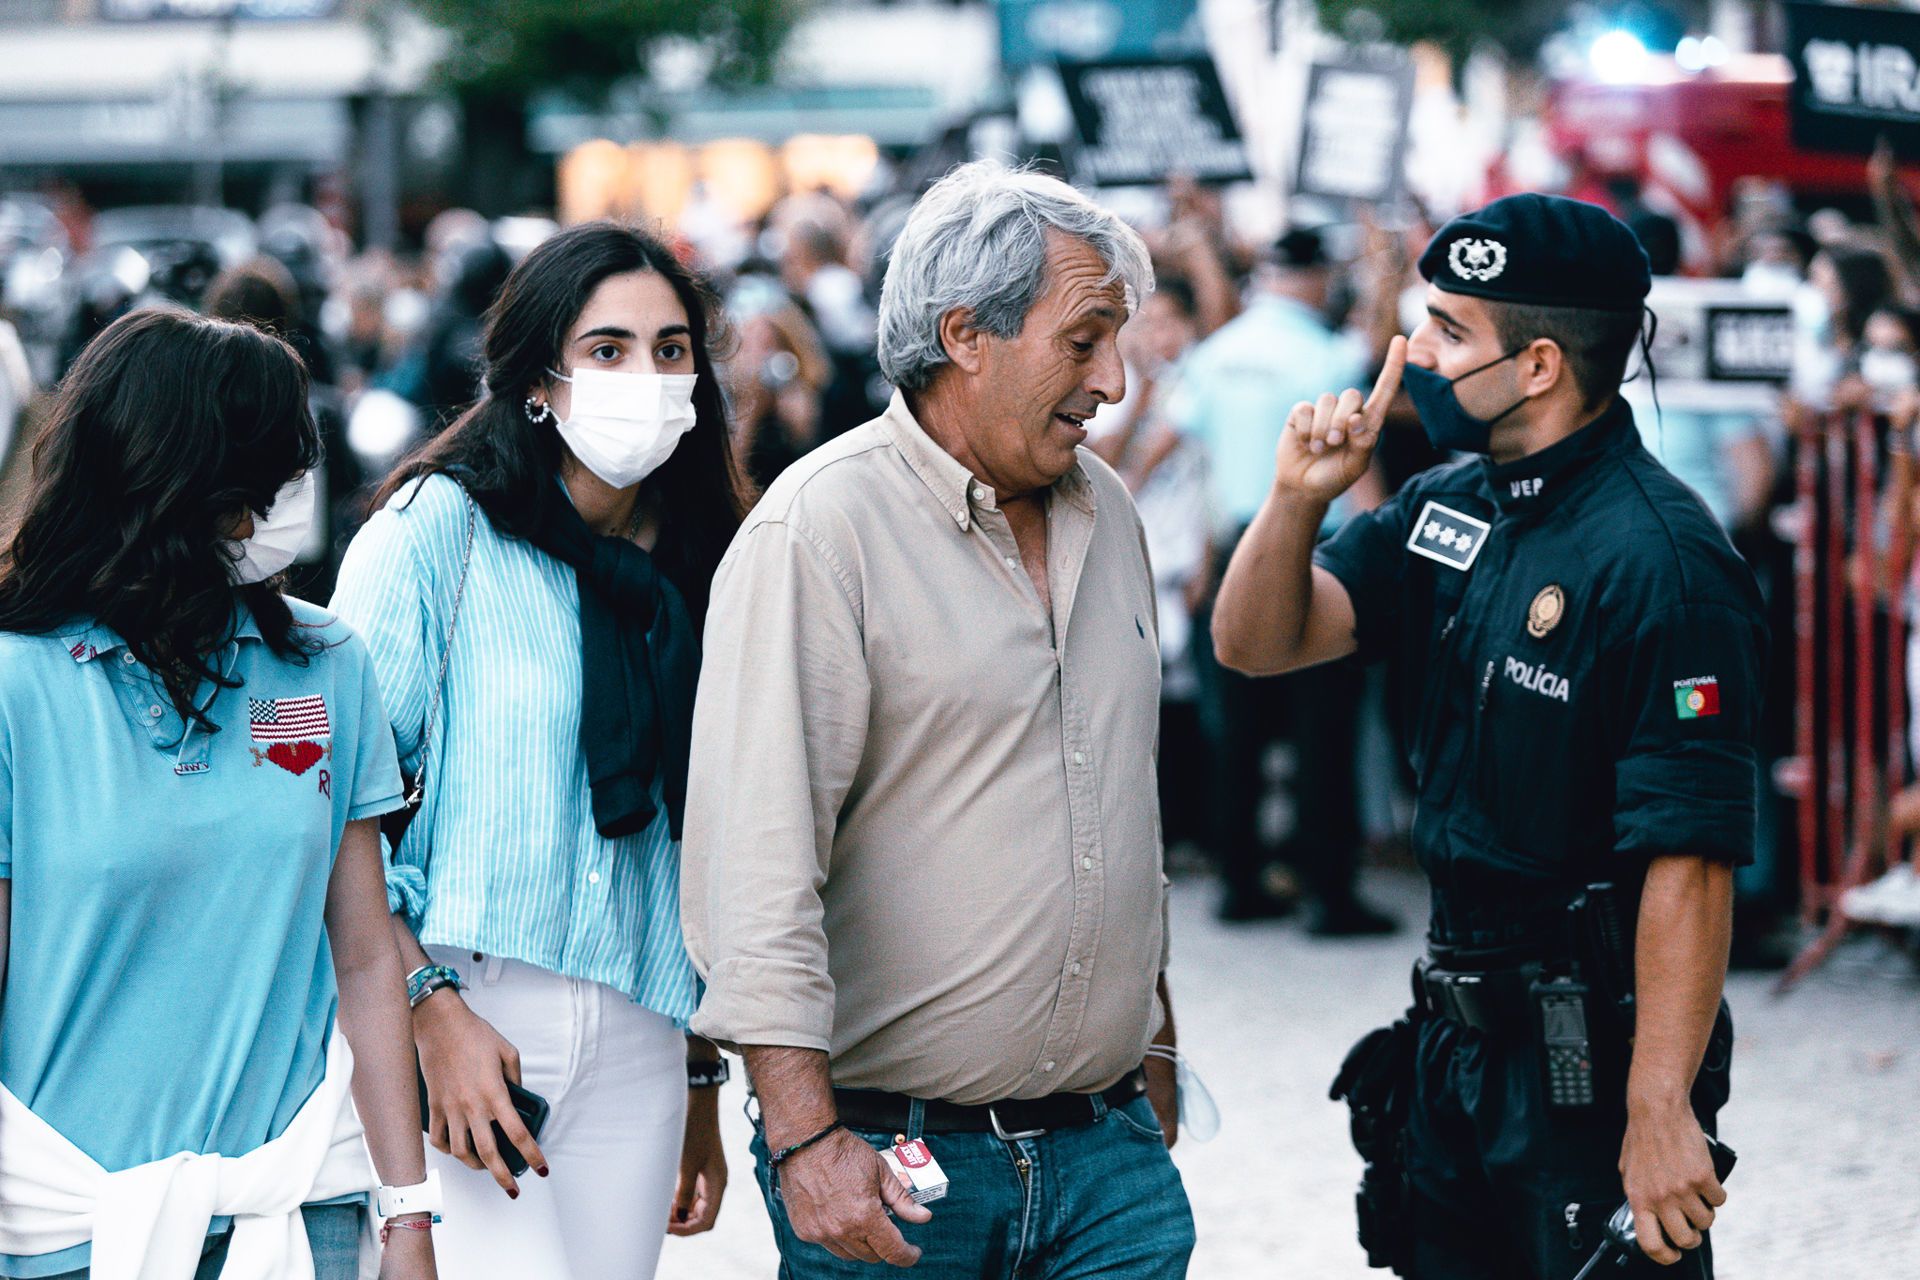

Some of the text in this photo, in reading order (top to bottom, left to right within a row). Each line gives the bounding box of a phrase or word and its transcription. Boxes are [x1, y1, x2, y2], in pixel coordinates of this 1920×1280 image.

[1858, 42, 1920, 113] IR
[1510, 478, 1543, 498] UEP
[1504, 656, 1569, 702] POLÍCIA
[1673, 675, 1717, 689] PORTUGAL
[900, 1146, 919, 1165] LUCKY
